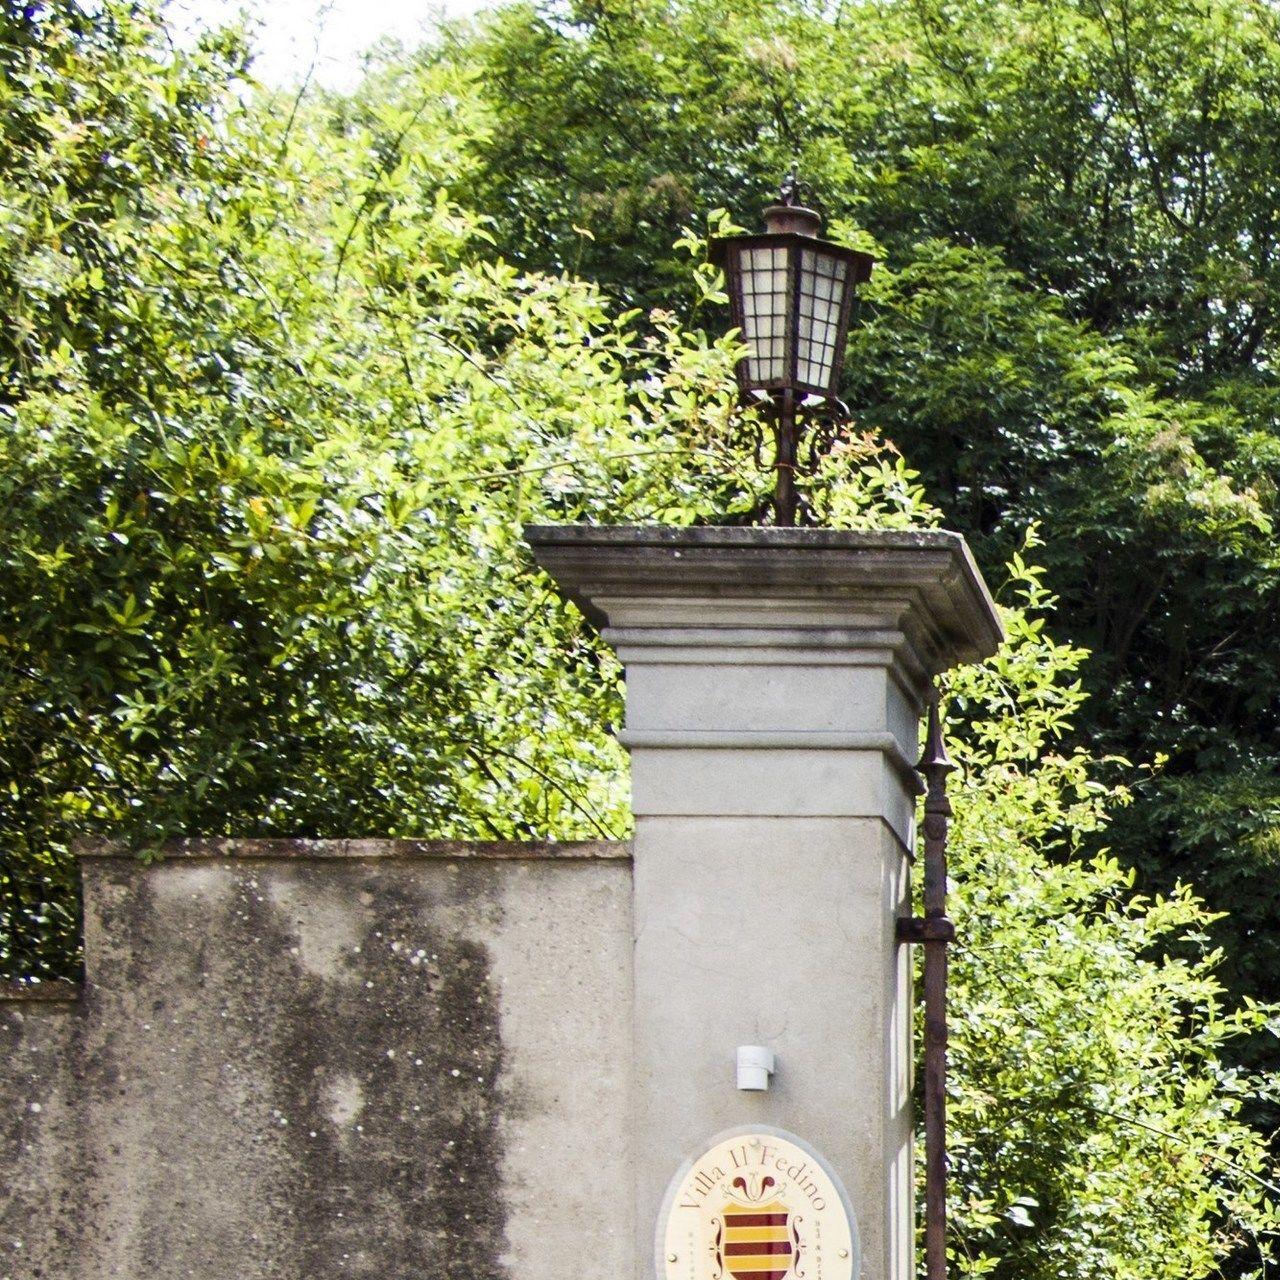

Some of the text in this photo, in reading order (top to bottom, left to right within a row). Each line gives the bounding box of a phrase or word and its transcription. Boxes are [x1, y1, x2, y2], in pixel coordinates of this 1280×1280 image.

[679, 1145, 827, 1212] Villa Il Fedino
